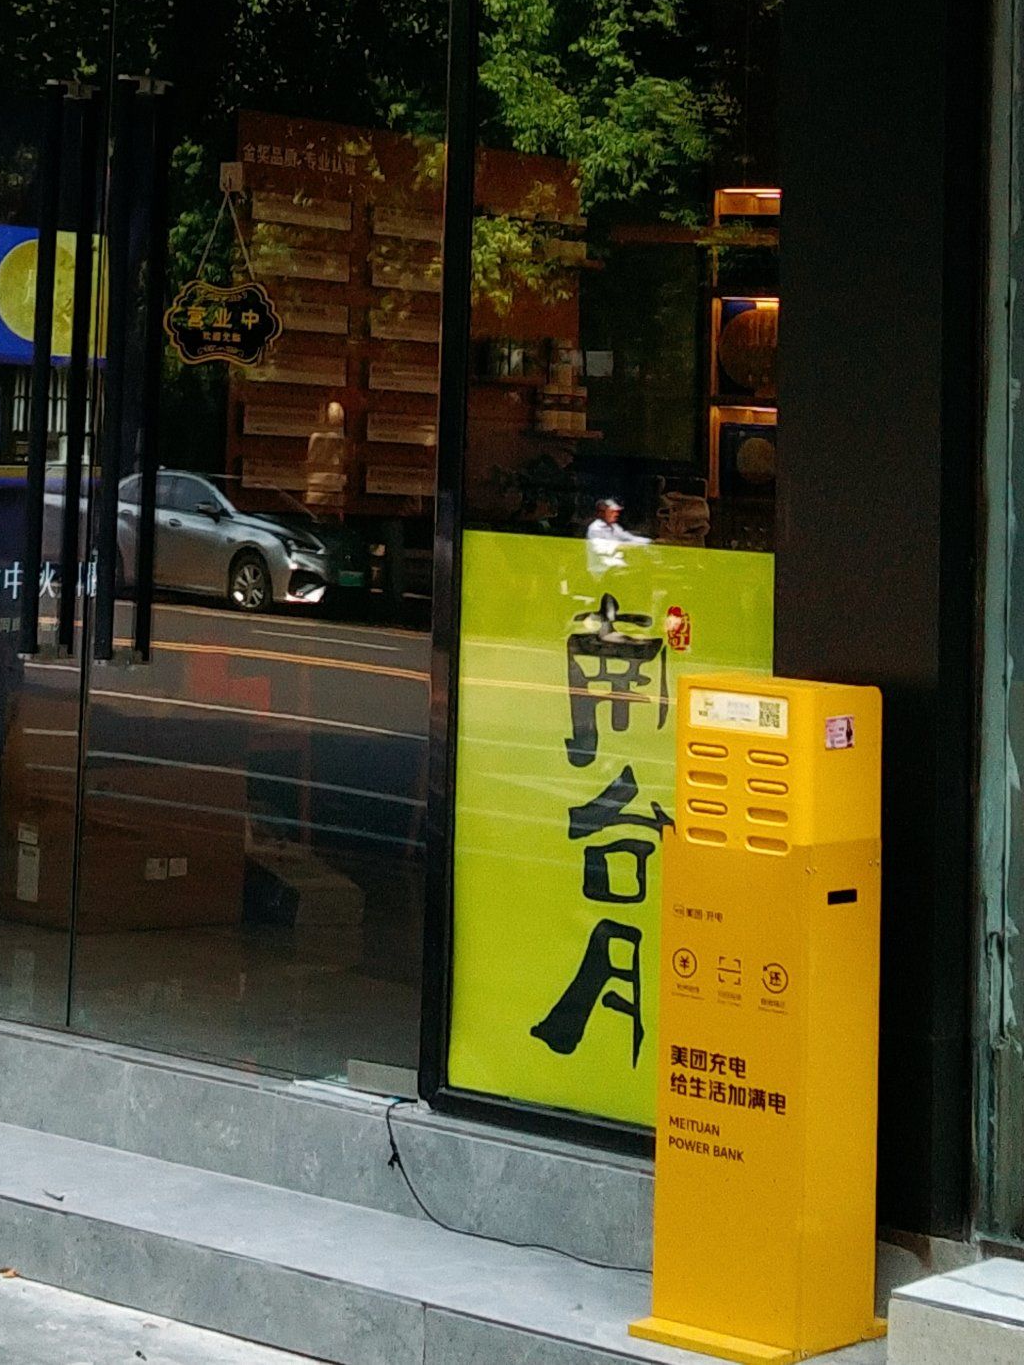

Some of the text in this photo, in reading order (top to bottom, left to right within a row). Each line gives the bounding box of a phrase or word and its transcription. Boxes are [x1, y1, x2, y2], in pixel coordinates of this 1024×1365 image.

[186, 305, 261, 331] 营业中
[670, 1044, 747, 1080] 美团充电
[669, 1071, 787, 1116] 给生活加满电
[668, 1114, 721, 1137] MEITUAN
[667, 1134, 745, 1164] POWER BANK
